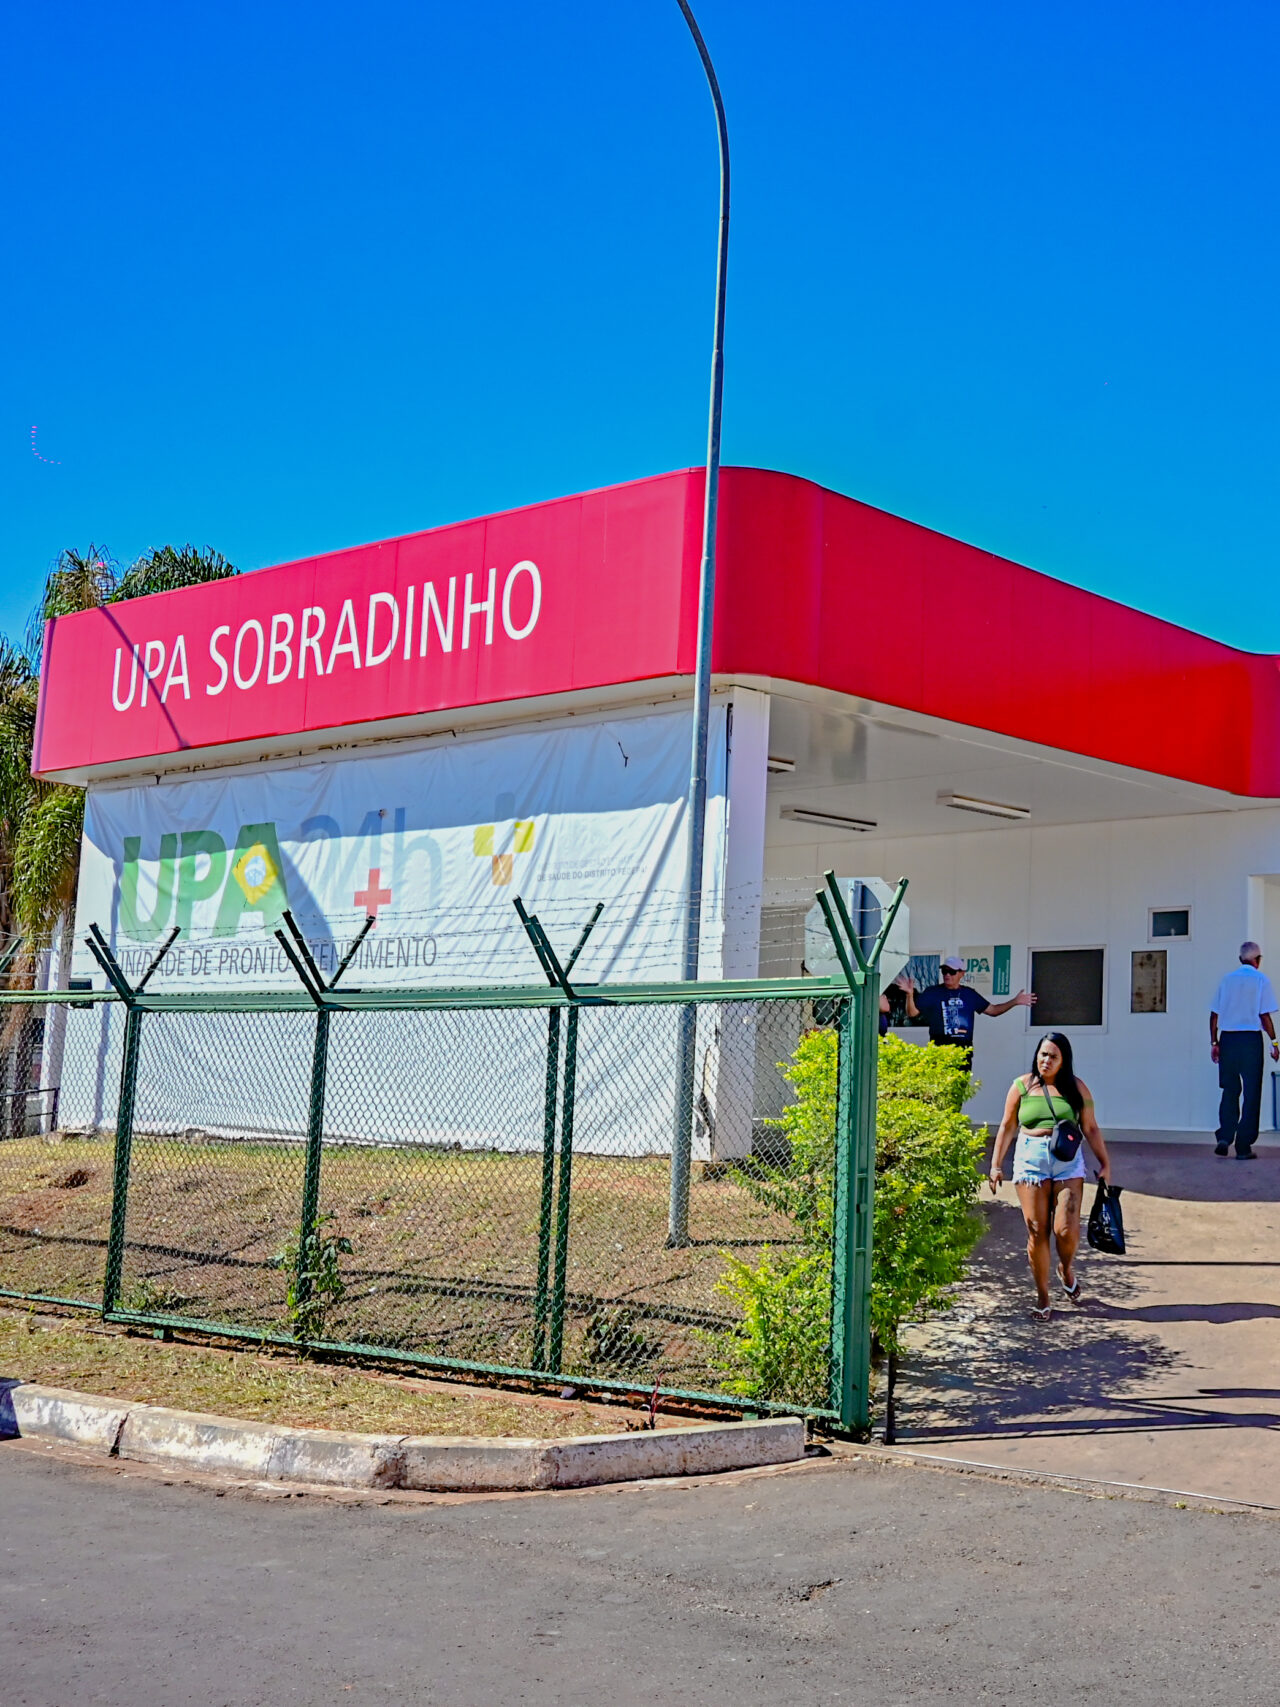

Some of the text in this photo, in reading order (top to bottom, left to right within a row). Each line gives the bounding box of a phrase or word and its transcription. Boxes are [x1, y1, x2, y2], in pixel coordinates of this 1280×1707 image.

[112, 560, 542, 712] UPA SOBRADINHO
[119, 807, 442, 941] UPA 24h
[191, 949, 212, 976] DE
[219, 945, 291, 975] PRONTO
[299, 937, 438, 972] TENDIMENTO
